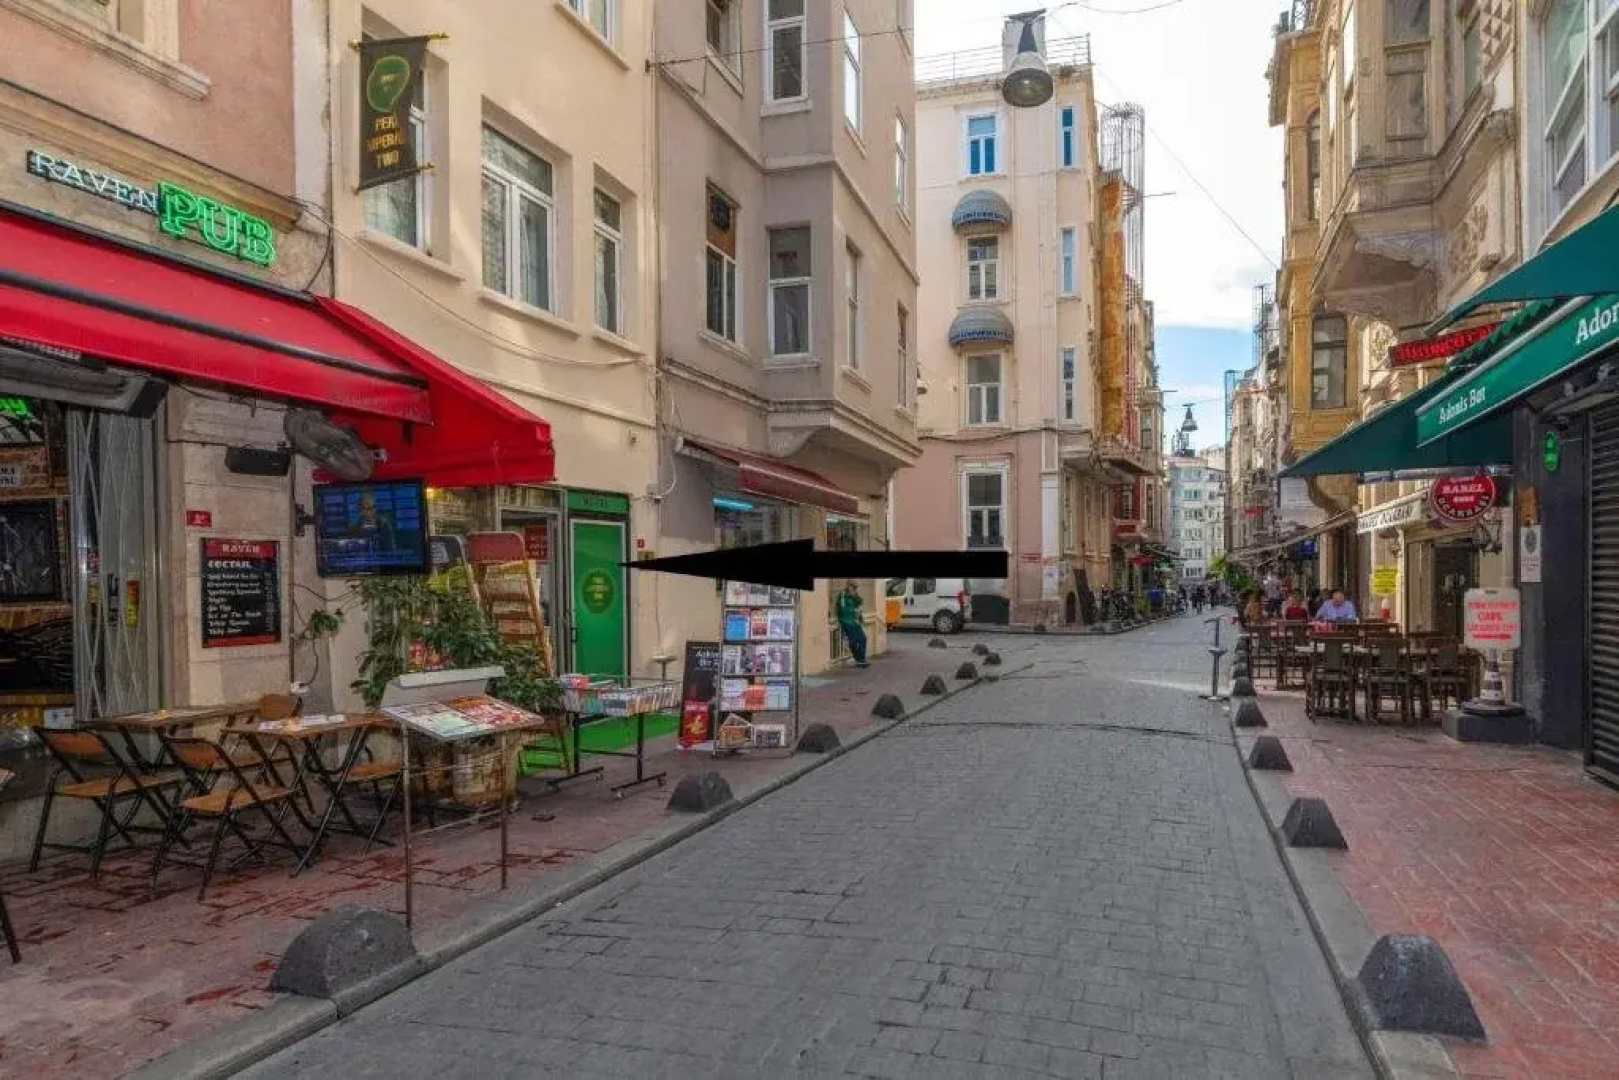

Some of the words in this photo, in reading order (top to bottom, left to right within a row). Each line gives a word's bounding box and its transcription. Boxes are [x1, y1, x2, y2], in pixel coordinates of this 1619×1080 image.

[35, 152, 158, 214] RAVEN
[160, 182, 276, 265] PUB
[1439, 397, 1468, 425] Adonis
[222, 543, 260, 553] RAVEN
